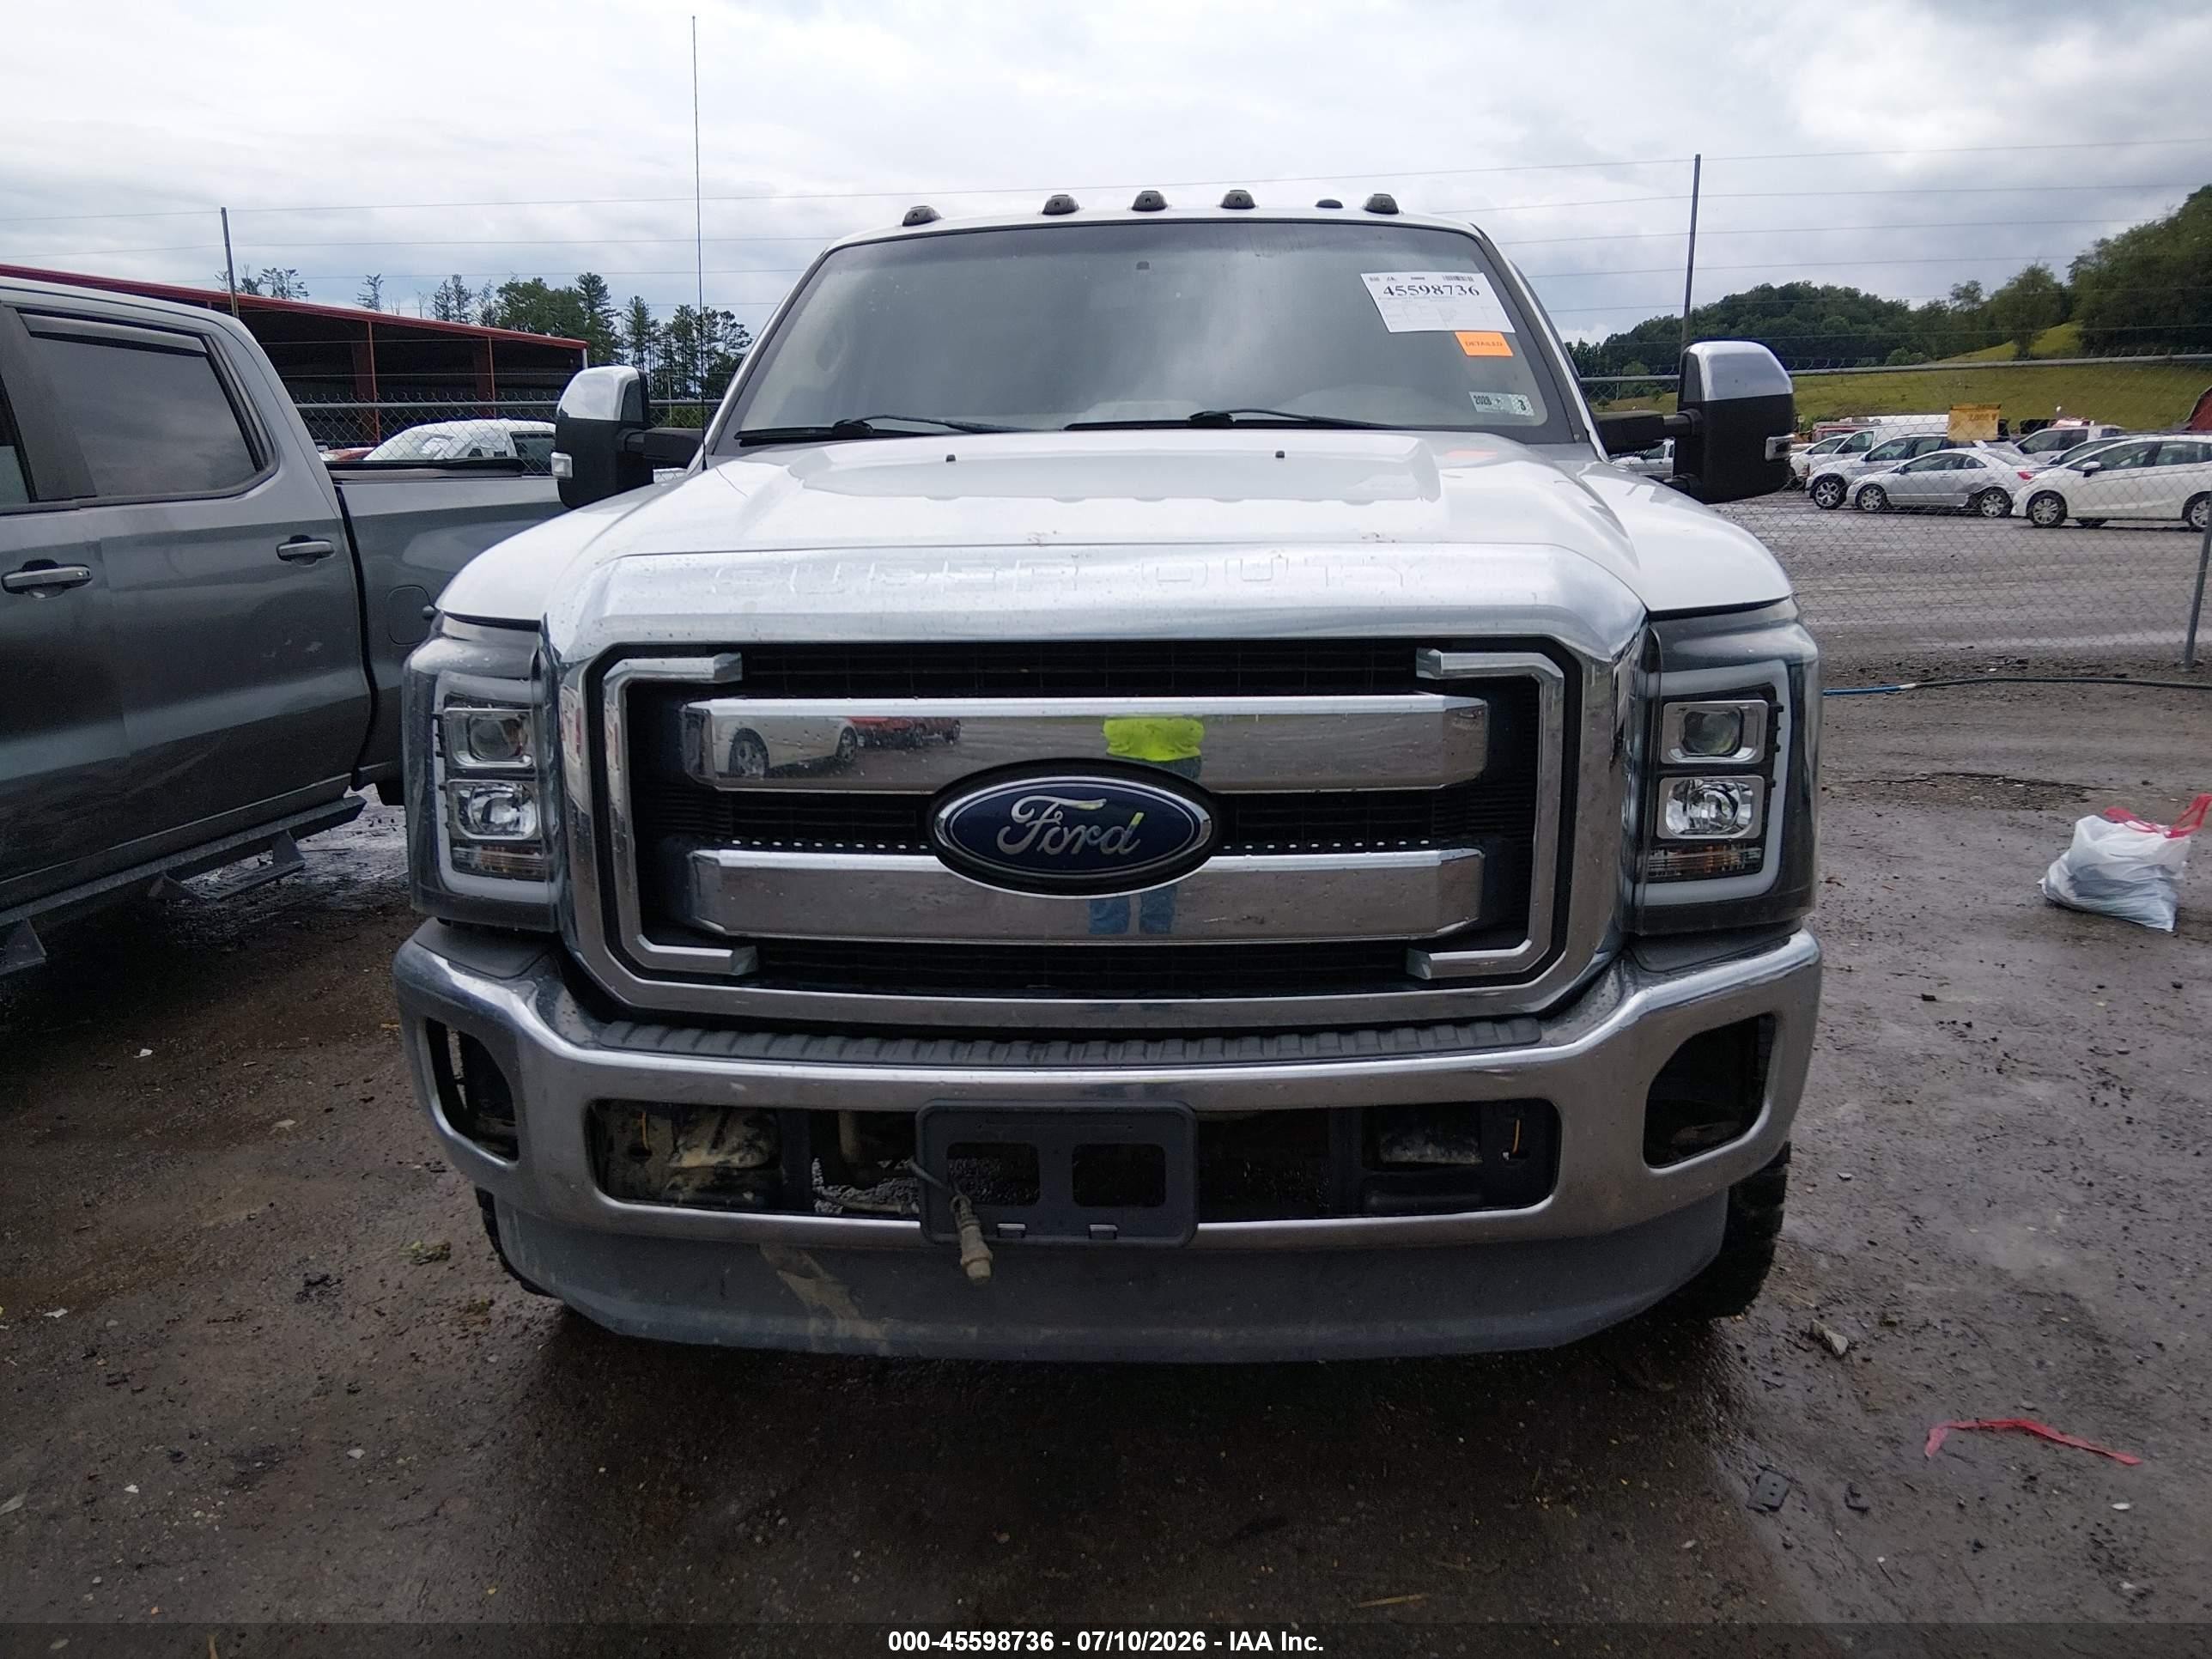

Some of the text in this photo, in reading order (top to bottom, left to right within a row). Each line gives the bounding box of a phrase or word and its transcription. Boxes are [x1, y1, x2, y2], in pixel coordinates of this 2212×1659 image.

[1382, 284, 1480, 297] 45598736
[711, 556, 1426, 594] SUPER DUTY
[996, 795, 1142, 855] Ford
